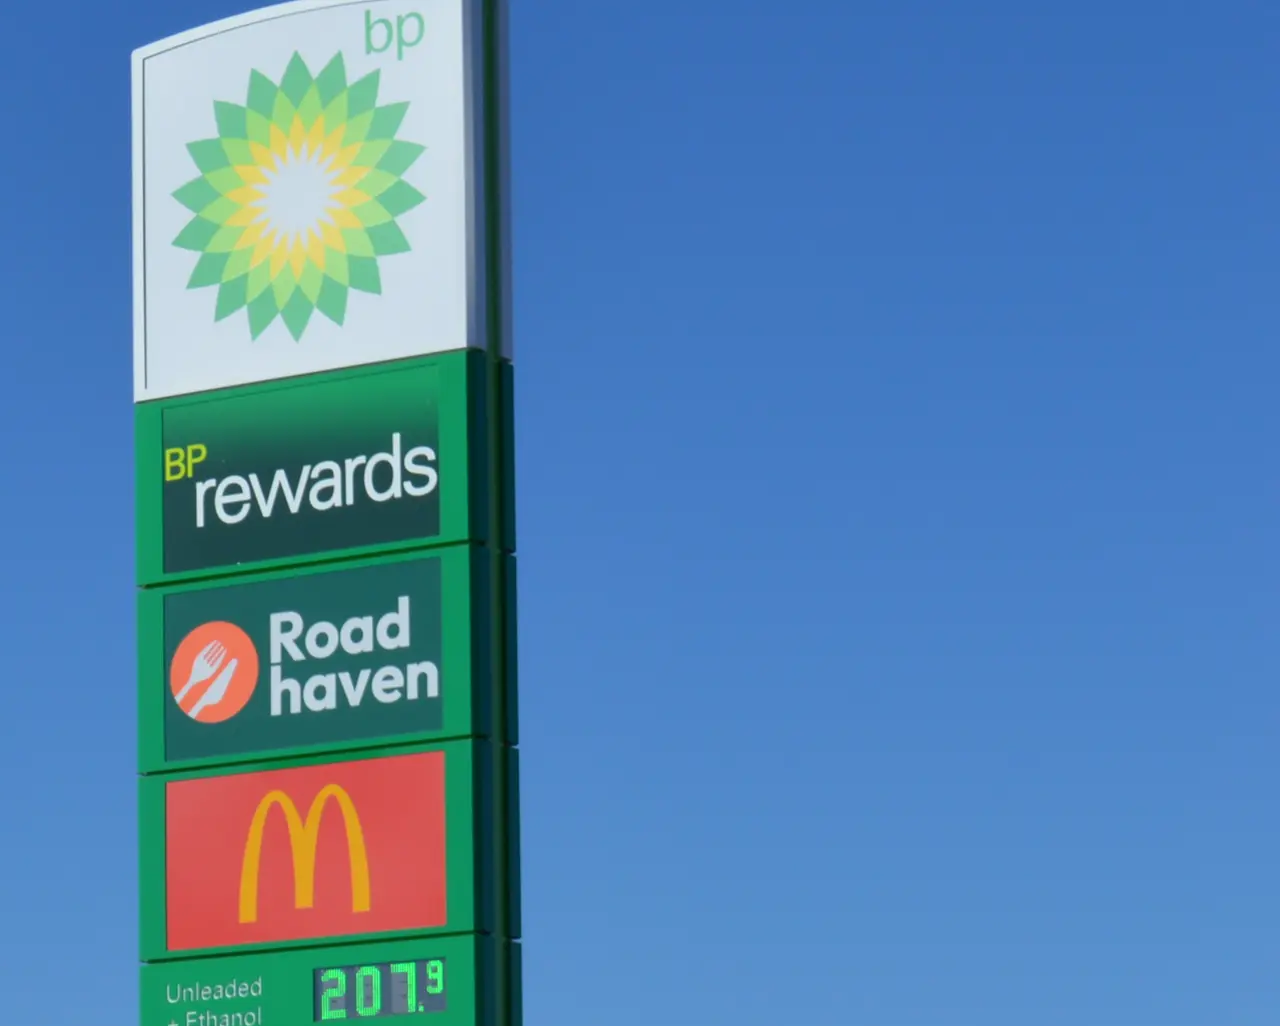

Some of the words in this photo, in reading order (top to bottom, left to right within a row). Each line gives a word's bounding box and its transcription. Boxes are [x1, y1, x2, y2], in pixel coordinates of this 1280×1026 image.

[364, 9, 425, 60] bp
[164, 444, 207, 481] BP
[195, 432, 439, 528] rewards
[269, 595, 411, 664] Road
[270, 659, 439, 716] haven
[166, 977, 262, 1004] Unleaded
